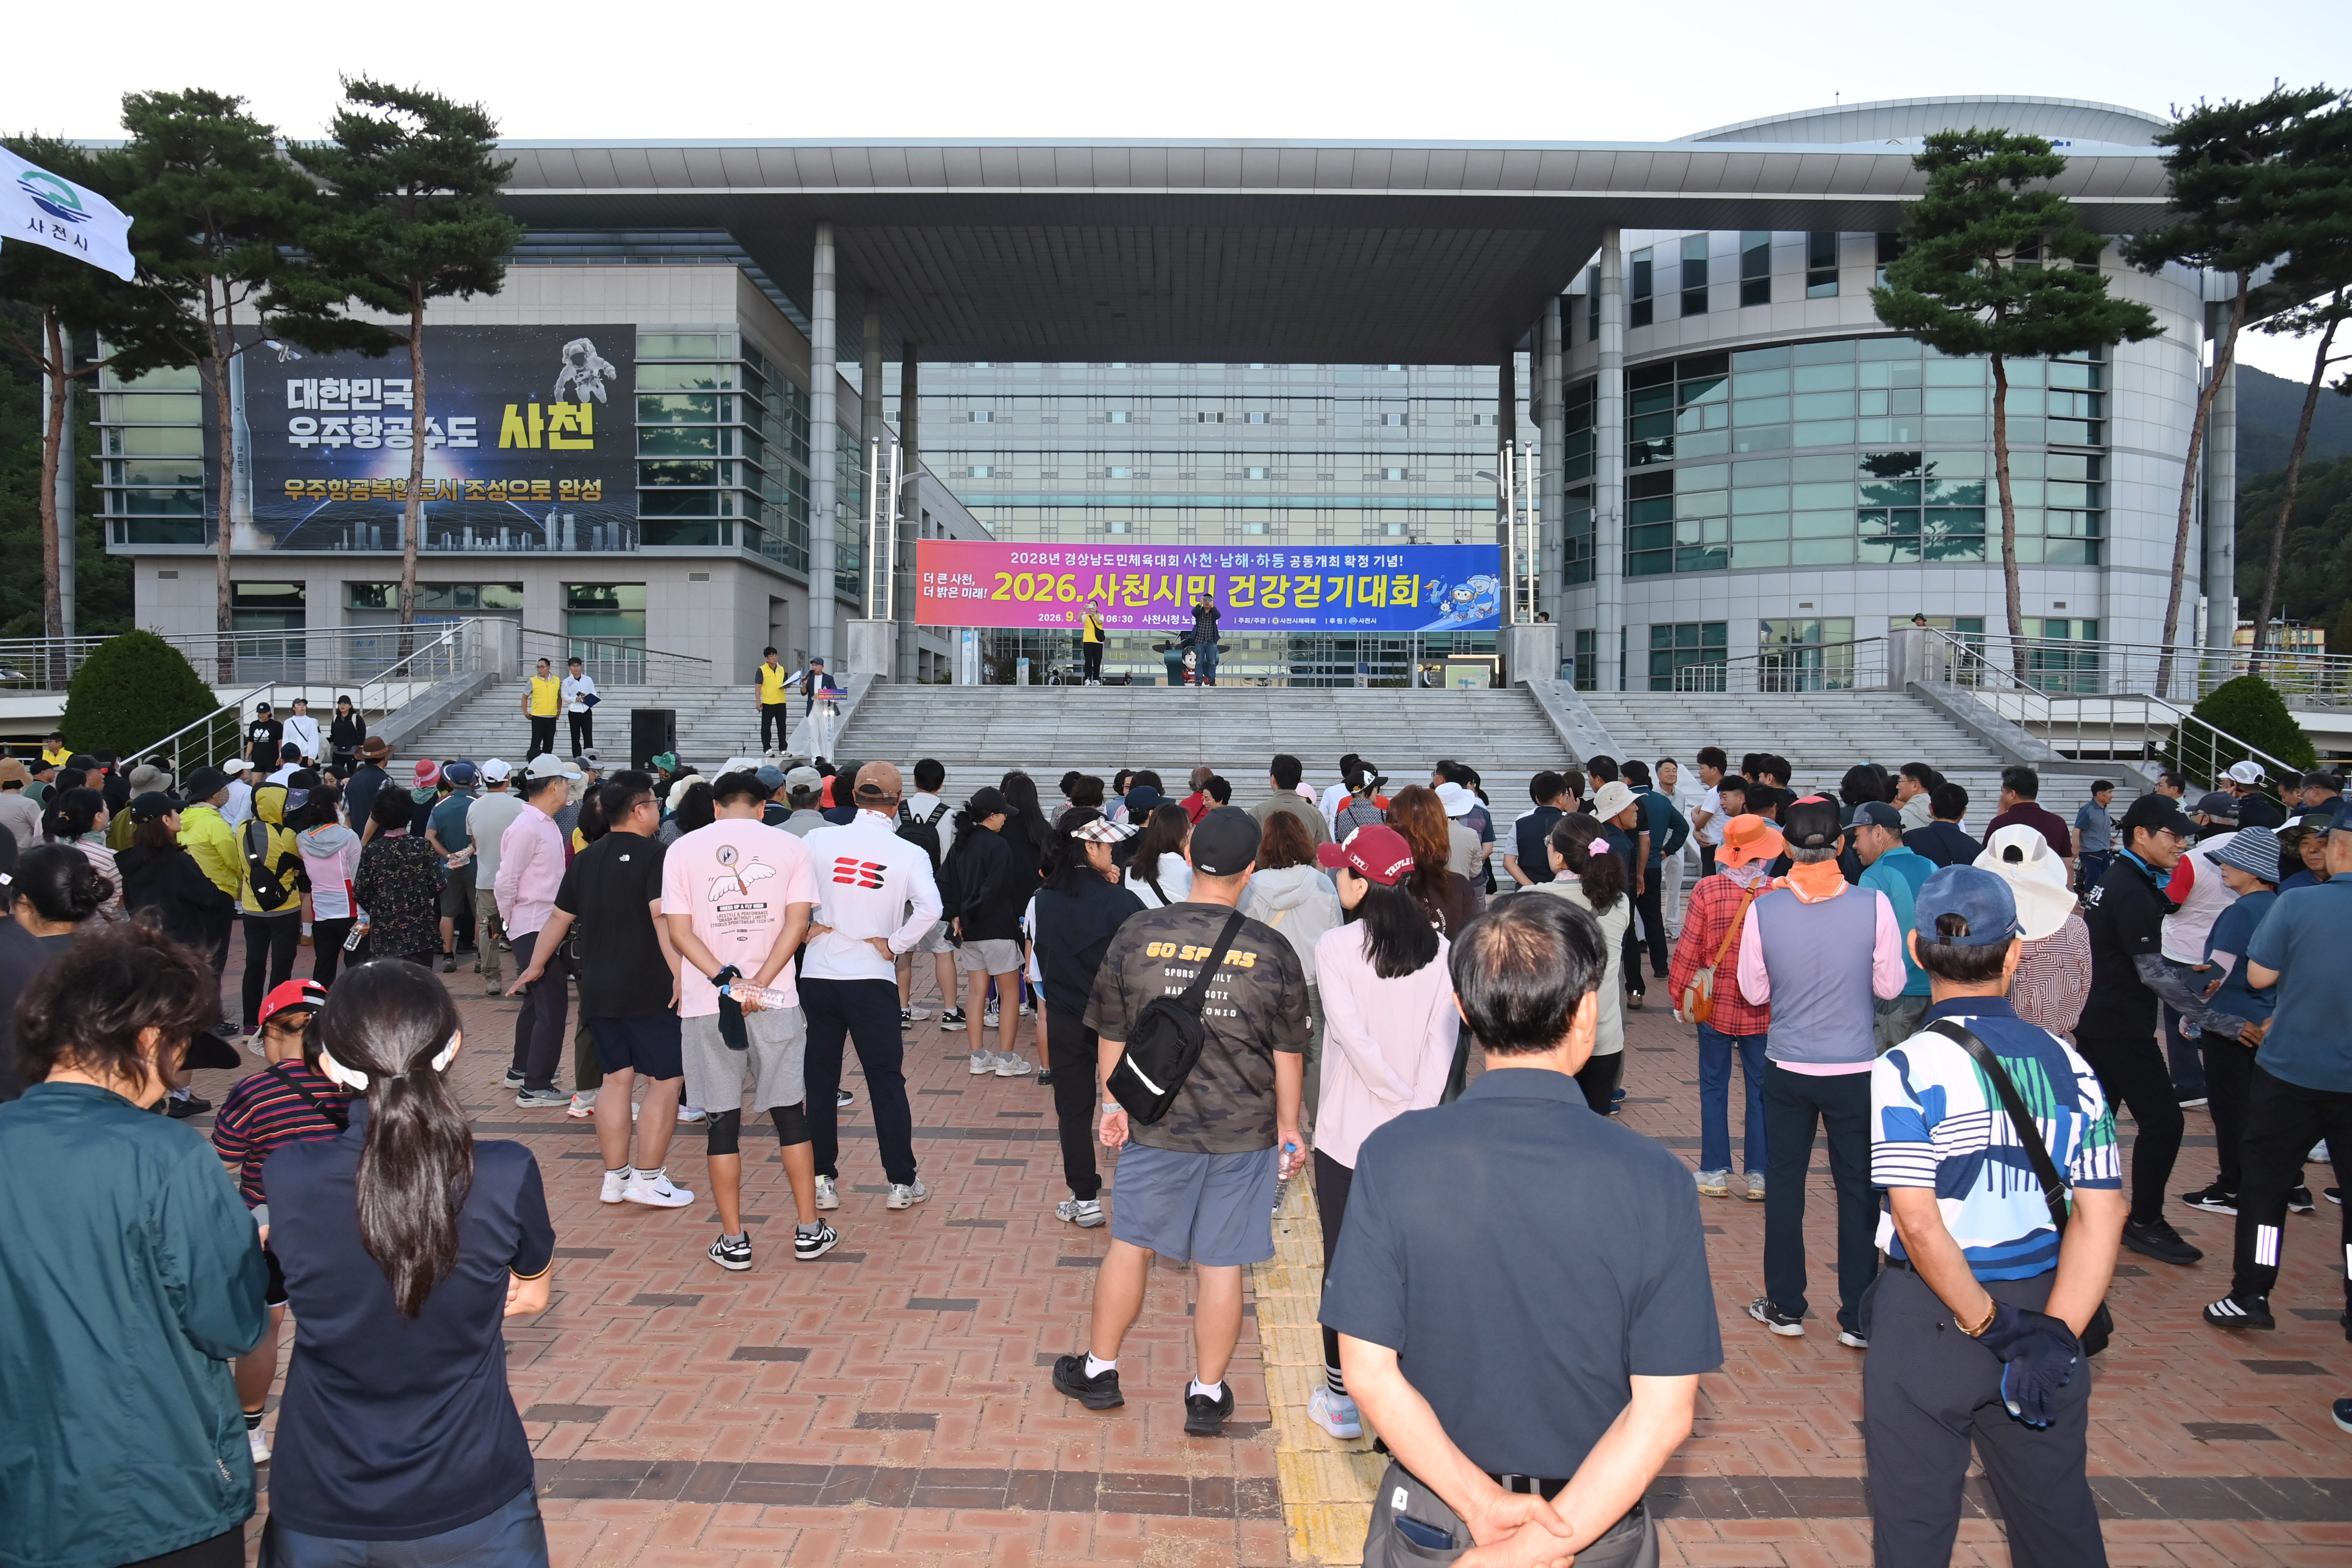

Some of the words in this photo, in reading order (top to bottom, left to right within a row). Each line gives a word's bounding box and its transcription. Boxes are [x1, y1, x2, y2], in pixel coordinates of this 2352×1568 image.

[27, 217, 88, 251] 사천시
[287, 377, 414, 411] 대한민국
[288, 416, 478, 449] 우주항공수도
[498, 401, 594, 450] 사천
[284, 479, 458, 502] 우주항공복합도시
[464, 479, 552, 502] 조성으로
[558, 478, 602, 502] 완성
[1010, 553, 1060, 566] 2028년
[1064, 553, 1179, 567] 경상남도민체육대회
[1183, 553, 1285, 568] 사천·남해·하동
[1289, 555, 1340, 568] 공동개최
[1344, 555, 1369, 568] 확정
[1373, 554, 1403, 567] 기념!
[923, 572, 934, 584] 더
[937, 573, 948, 584] 큰
[950, 574, 975, 586] 사천,
[923, 586, 934, 598] 더
[936, 586, 958, 599] 밝은
[961, 588, 988, 599] 미래!
[1228, 573, 1420, 608] 건강걷기대회
[1038, 613, 1064, 622] 2026.
[1106, 615, 1133, 623] 06:30
[1142, 615, 1180, 625] 사천시청
[1384, 858, 1410, 877] TRIPLE
[1146, 942, 1176, 958] GO
[1179, 945, 1257, 968] SPRS
[1165, 968, 1194, 978] SPURS
[1165, 986, 1187, 995] MAD
